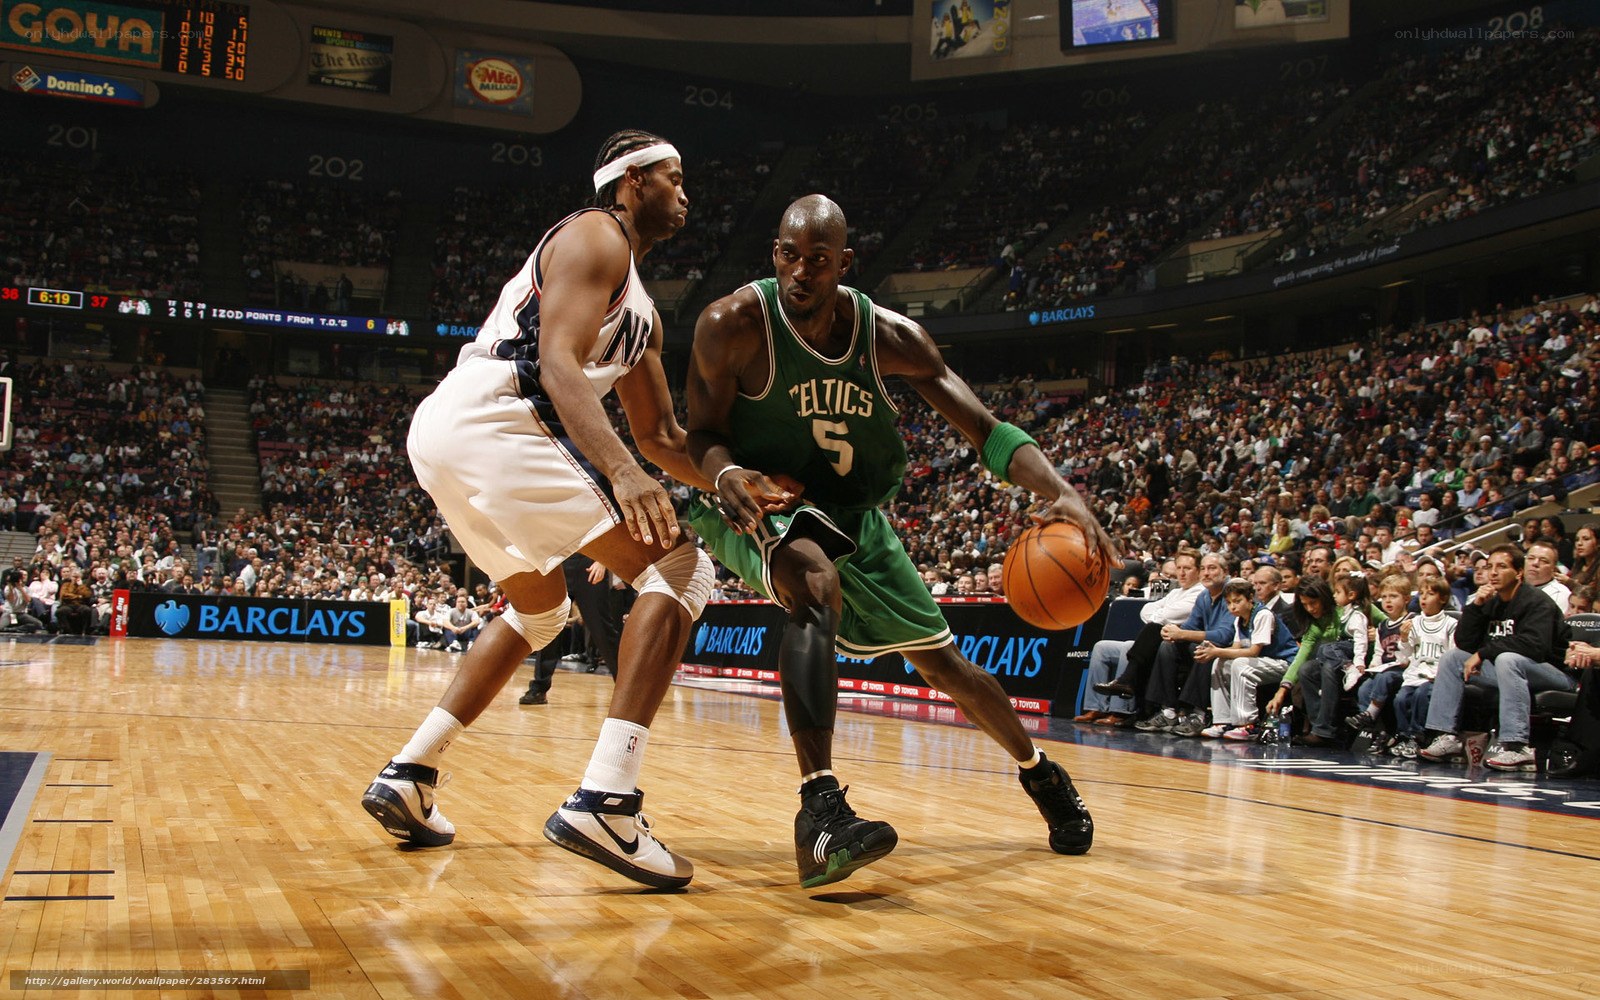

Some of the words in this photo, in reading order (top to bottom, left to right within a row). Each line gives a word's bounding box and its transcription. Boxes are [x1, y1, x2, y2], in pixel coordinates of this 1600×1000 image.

[8, 3, 154, 54] GOYA
[199, 11, 215, 24] 10
[238, 16, 248, 29] 5
[1487, 6, 1544, 40] 208
[204, 25, 214, 38] 0
[179, 47, 188, 60] 2
[202, 50, 212, 63] 3
[226, 40, 246, 55] 20
[312, 52, 344, 67] The
[201, 63, 211, 76] 5
[225, 67, 244, 81] 50
[480, 66, 518, 84] MEGA
[47, 75, 115, 97] Domino's
[684, 84, 734, 111] 204
[46, 123, 98, 150] 201
[491, 142, 543, 167] 203
[307, 155, 364, 181] 202
[39, 291, 71, 305] 6:19
[90, 295, 109, 308] 37
[168, 307, 177, 317] 2
[198, 309, 204, 319] 1
[212, 308, 243, 320] IZOD
[246, 311, 282, 322] POINTS
[287, 315, 314, 325] FROM
[366, 319, 375, 330] 6
[1041, 305, 1095, 323] BARCLAYS
[788, 378, 873, 418] CELTICS
[811, 418, 854, 477] 5
[198, 603, 366, 638] BARCLAYS
[705, 626, 768, 656] BARCLAYS
[953, 634, 1049, 678] RCLAYS
[868, 683, 885, 692] TOYOTA
[901, 687, 919, 696] TOYOTA
[1018, 700, 1041, 710] TOYOTA
